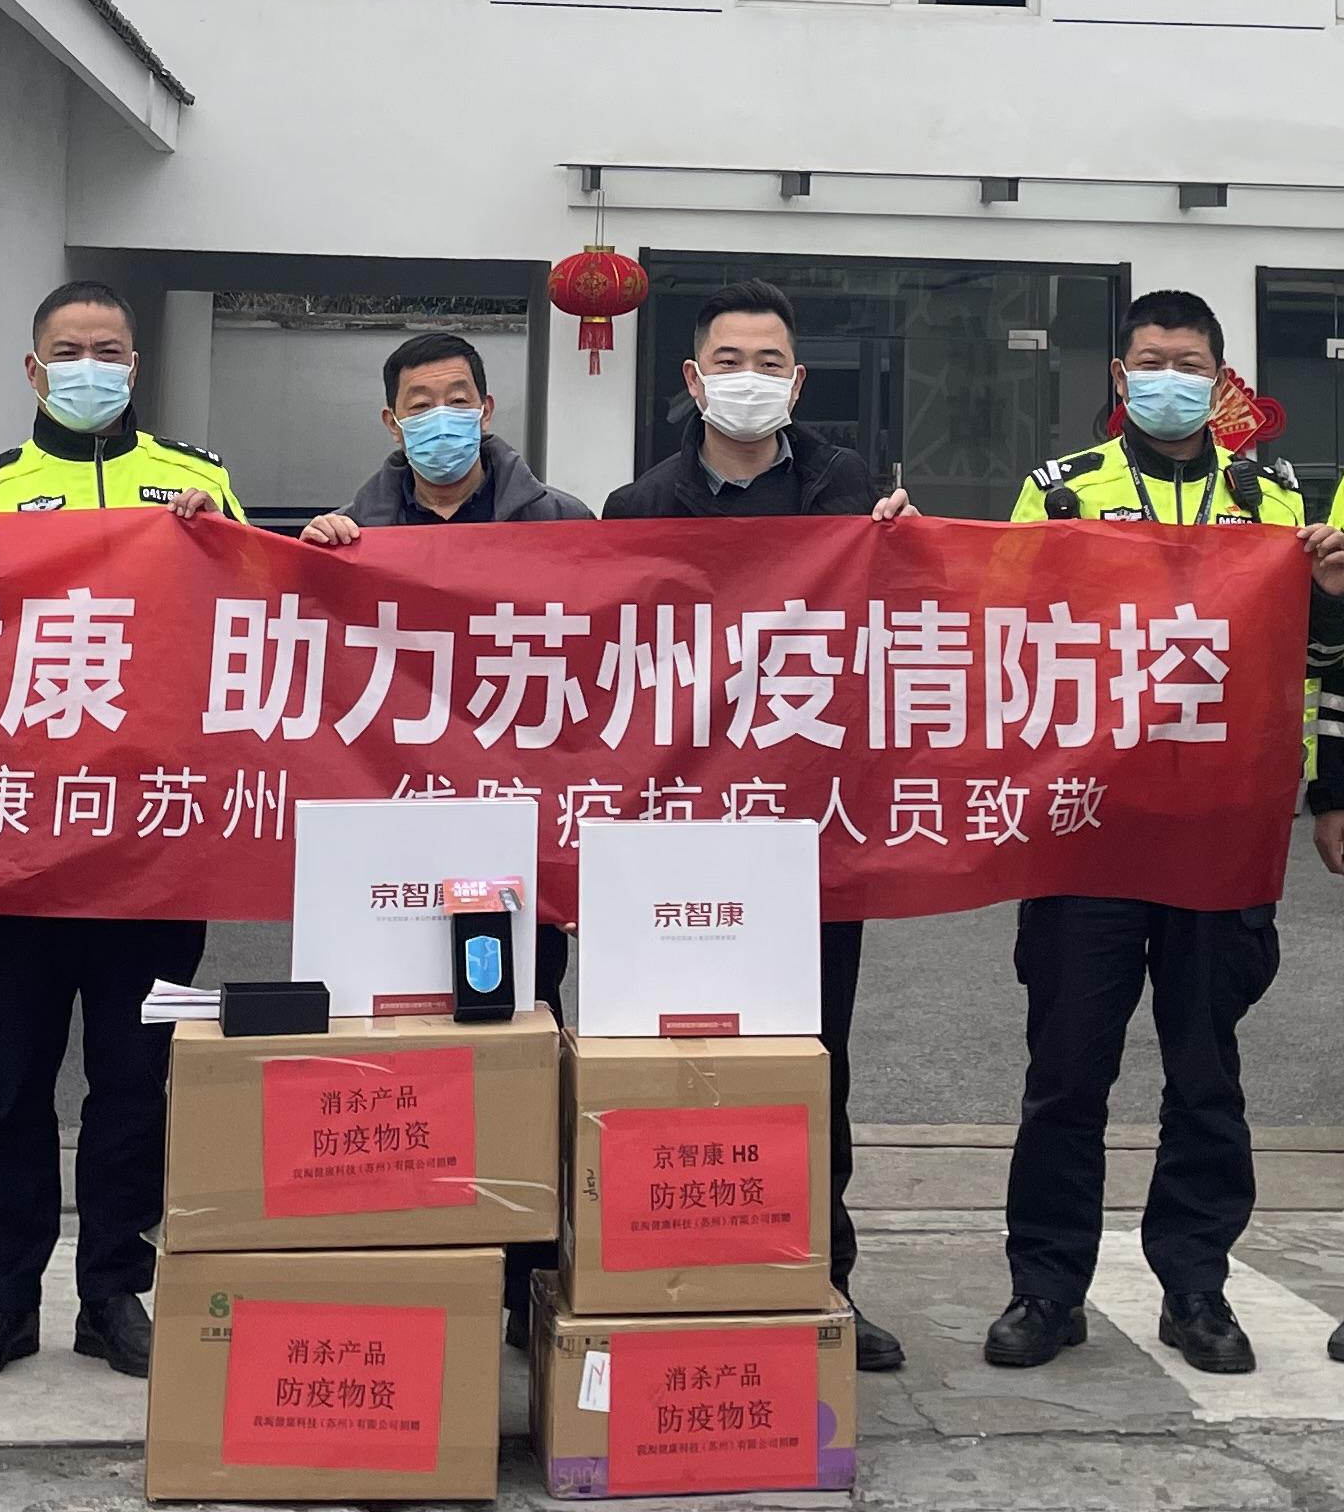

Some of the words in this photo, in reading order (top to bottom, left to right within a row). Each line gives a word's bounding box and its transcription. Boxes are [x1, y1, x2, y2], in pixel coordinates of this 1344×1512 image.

[201, 593, 1230, 752] 助力苏州疫情防控
[653, 902, 744, 927] 京智康
[320, 1085, 417, 1115] 消杀产品
[314, 1121, 430, 1157] 防疫物资
[652, 1141, 724, 1169] 京智康
[732, 1144, 759, 1163] H8
[650, 1176, 764, 1211] 防疫物资
[287, 1339, 386, 1366] 消杀产品
[665, 1362, 761, 1392] 消杀产品
[276, 1377, 395, 1410] 防疫物资
[657, 1399, 773, 1434] 防疫物资
